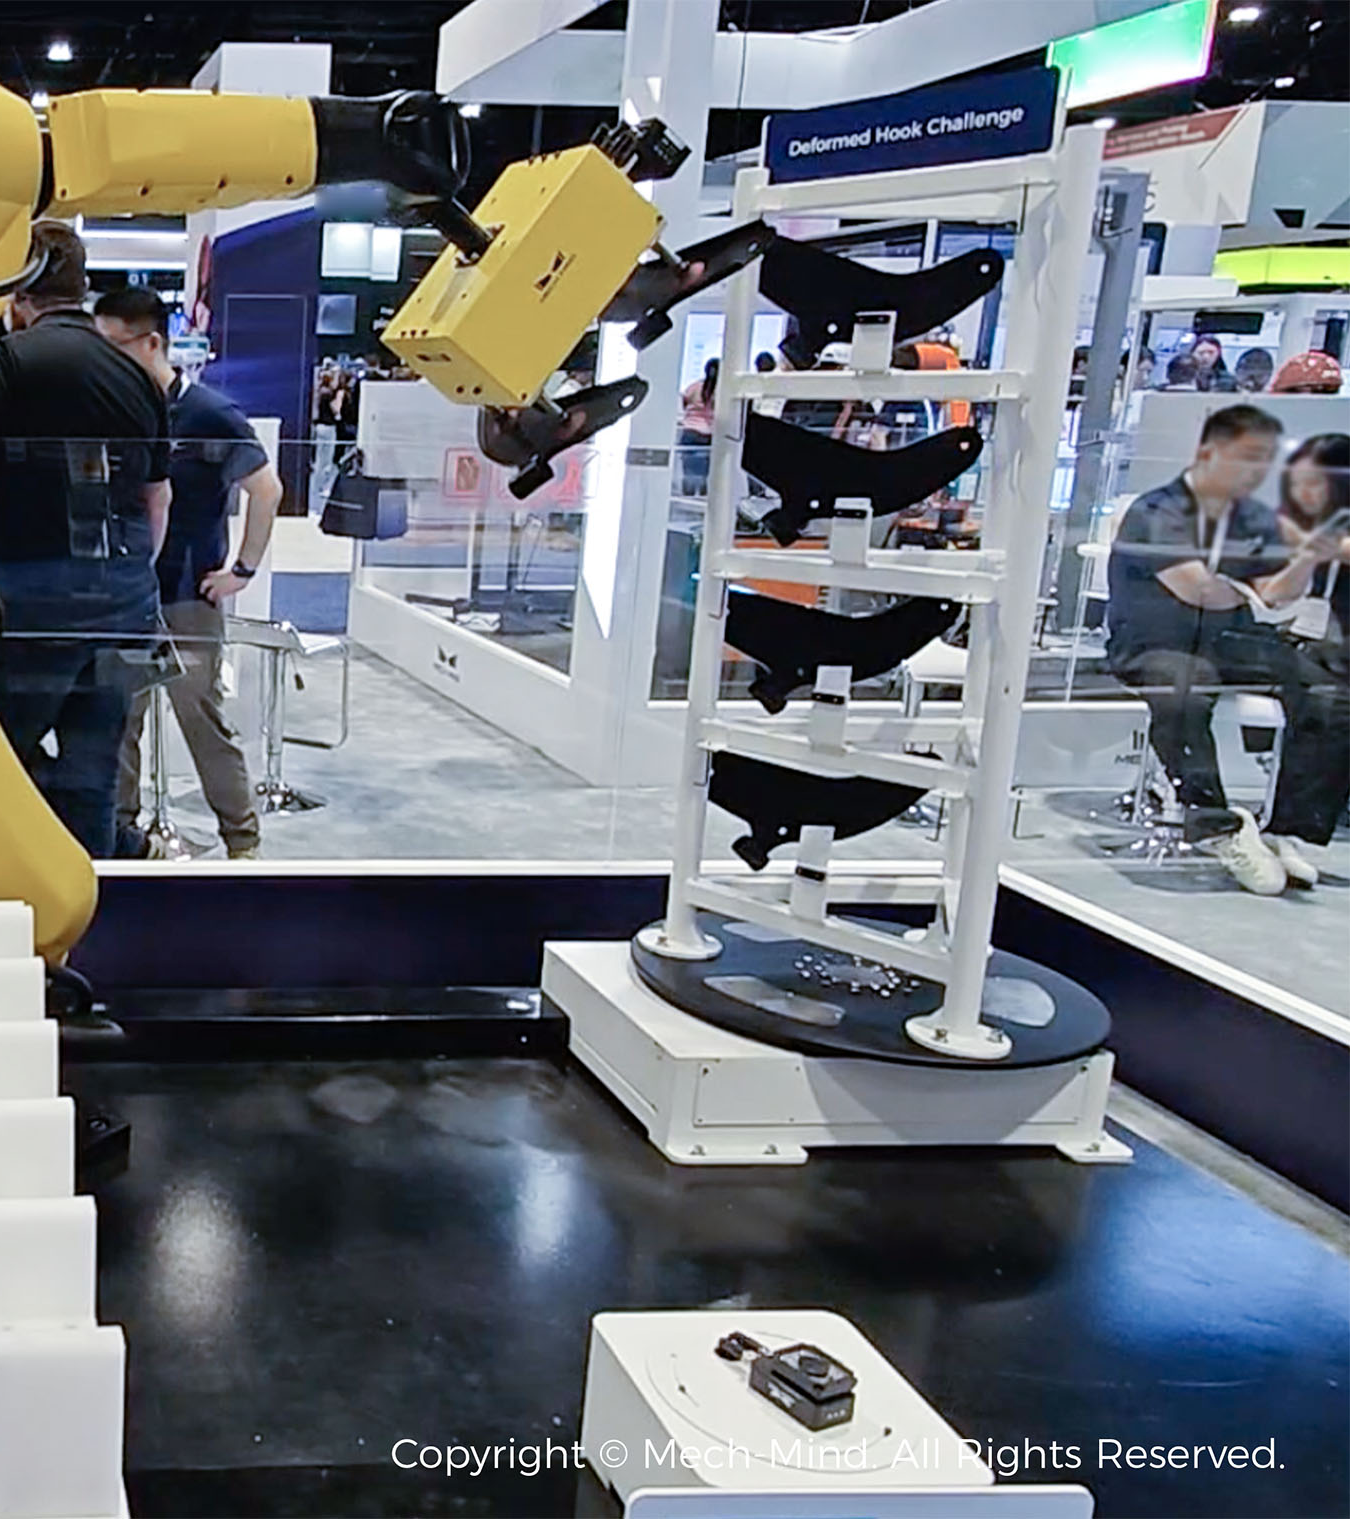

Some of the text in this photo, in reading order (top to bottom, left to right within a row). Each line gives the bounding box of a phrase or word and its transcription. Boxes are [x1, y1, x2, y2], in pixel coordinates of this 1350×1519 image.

[788, 106, 1025, 158] Deformed Hook Challenge
